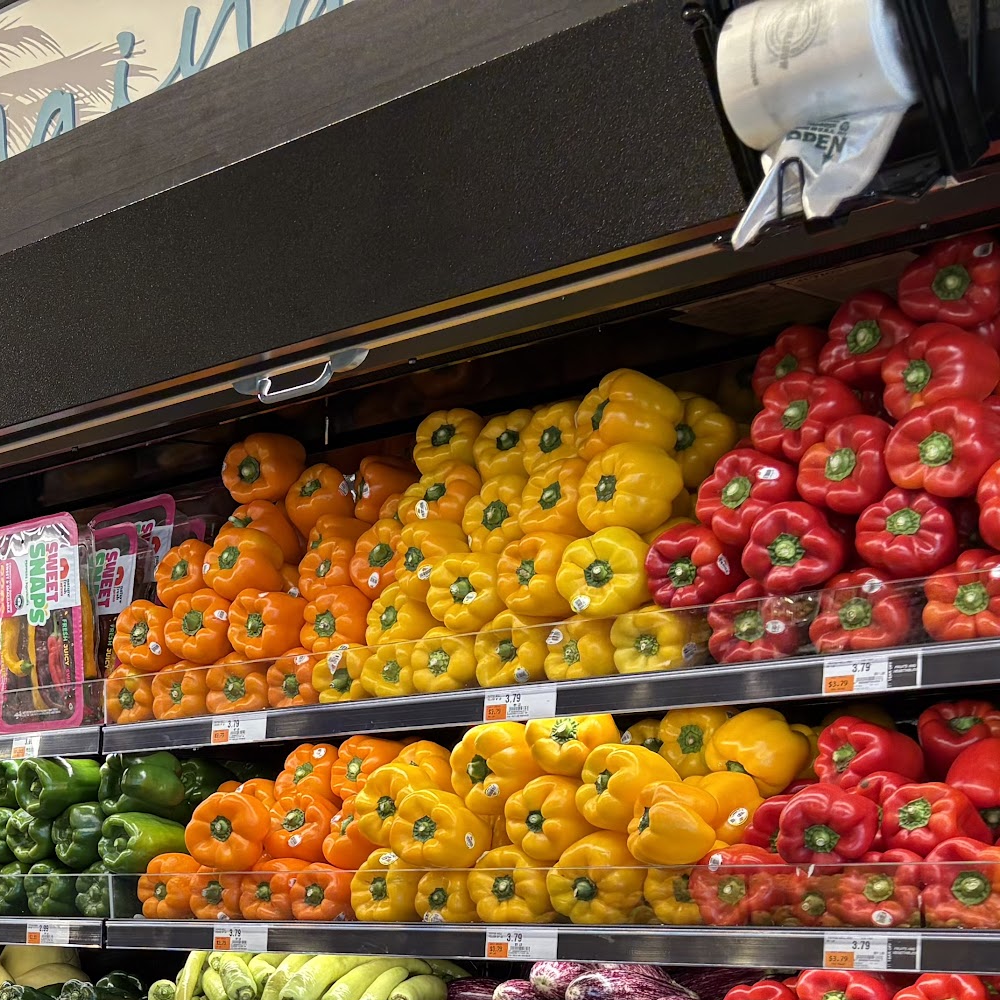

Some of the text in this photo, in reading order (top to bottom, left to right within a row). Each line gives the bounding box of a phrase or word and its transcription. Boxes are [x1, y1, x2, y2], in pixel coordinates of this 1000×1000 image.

[785, 130, 848, 164] OPEN
[46, 542, 58, 602] SWEET
[29, 542, 46, 624] SNAPS
[98, 550, 118, 608] SWEET
[104, 648, 112, 670] JUICY
[852, 662, 871, 672] 3.79
[828, 680, 848, 688] $3.79
[505, 693, 521, 703] 3.79
[228, 720, 240, 728] 3.79
[229, 928, 242, 937] 3.79
[506, 933, 522, 942] 3.79
[852, 940, 870, 950] 3.79
